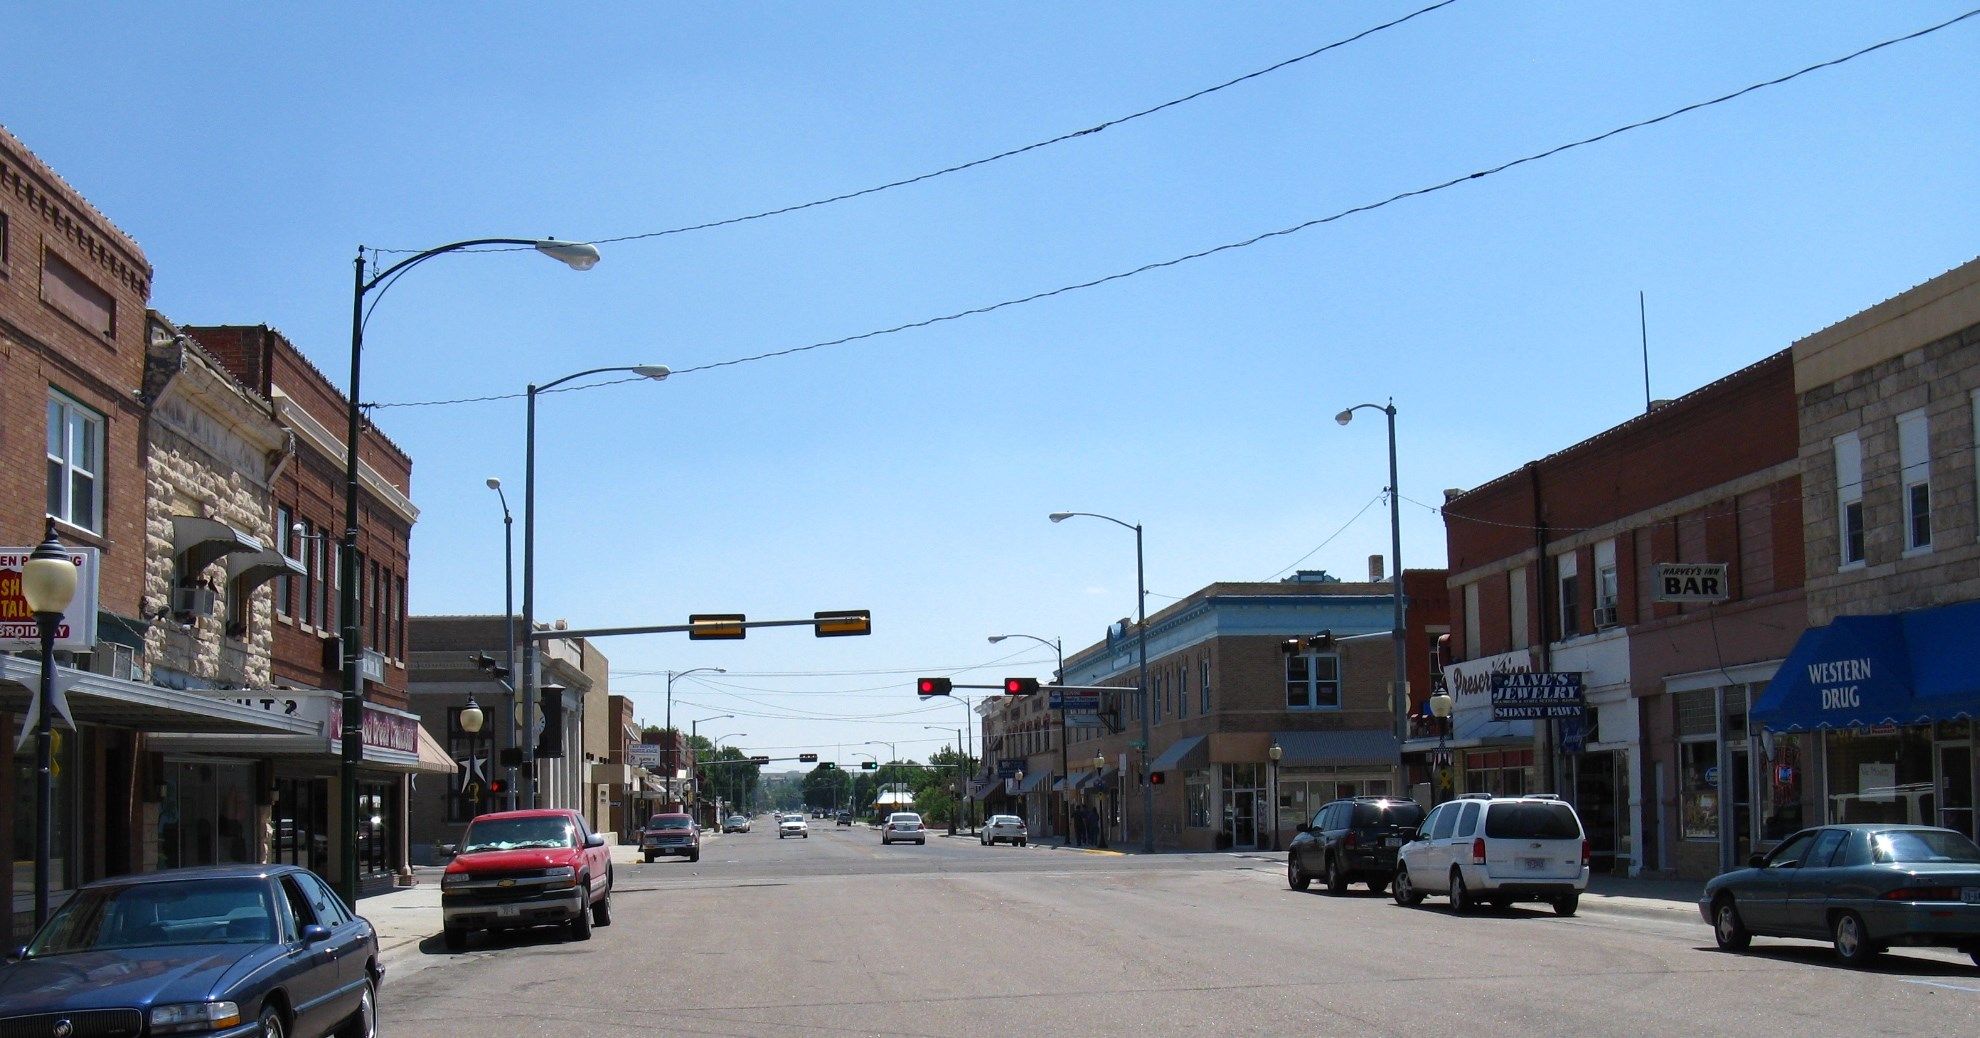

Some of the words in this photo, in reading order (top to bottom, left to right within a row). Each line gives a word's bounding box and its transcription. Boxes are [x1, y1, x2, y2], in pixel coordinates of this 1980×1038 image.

[1663, 567, 1702, 576] HARVEY'S
[1704, 568, 1720, 576] INN
[1665, 577, 1719, 595] BAR
[1807, 657, 1871, 684] WESTERN
[1504, 673, 1569, 687] JANE'S
[1493, 686, 1579, 700] JEWELRY
[1821, 685, 1860, 710] DRUG
[1494, 706, 1544, 718] SIDNEY
[1547, 706, 1581, 717] PAWN
